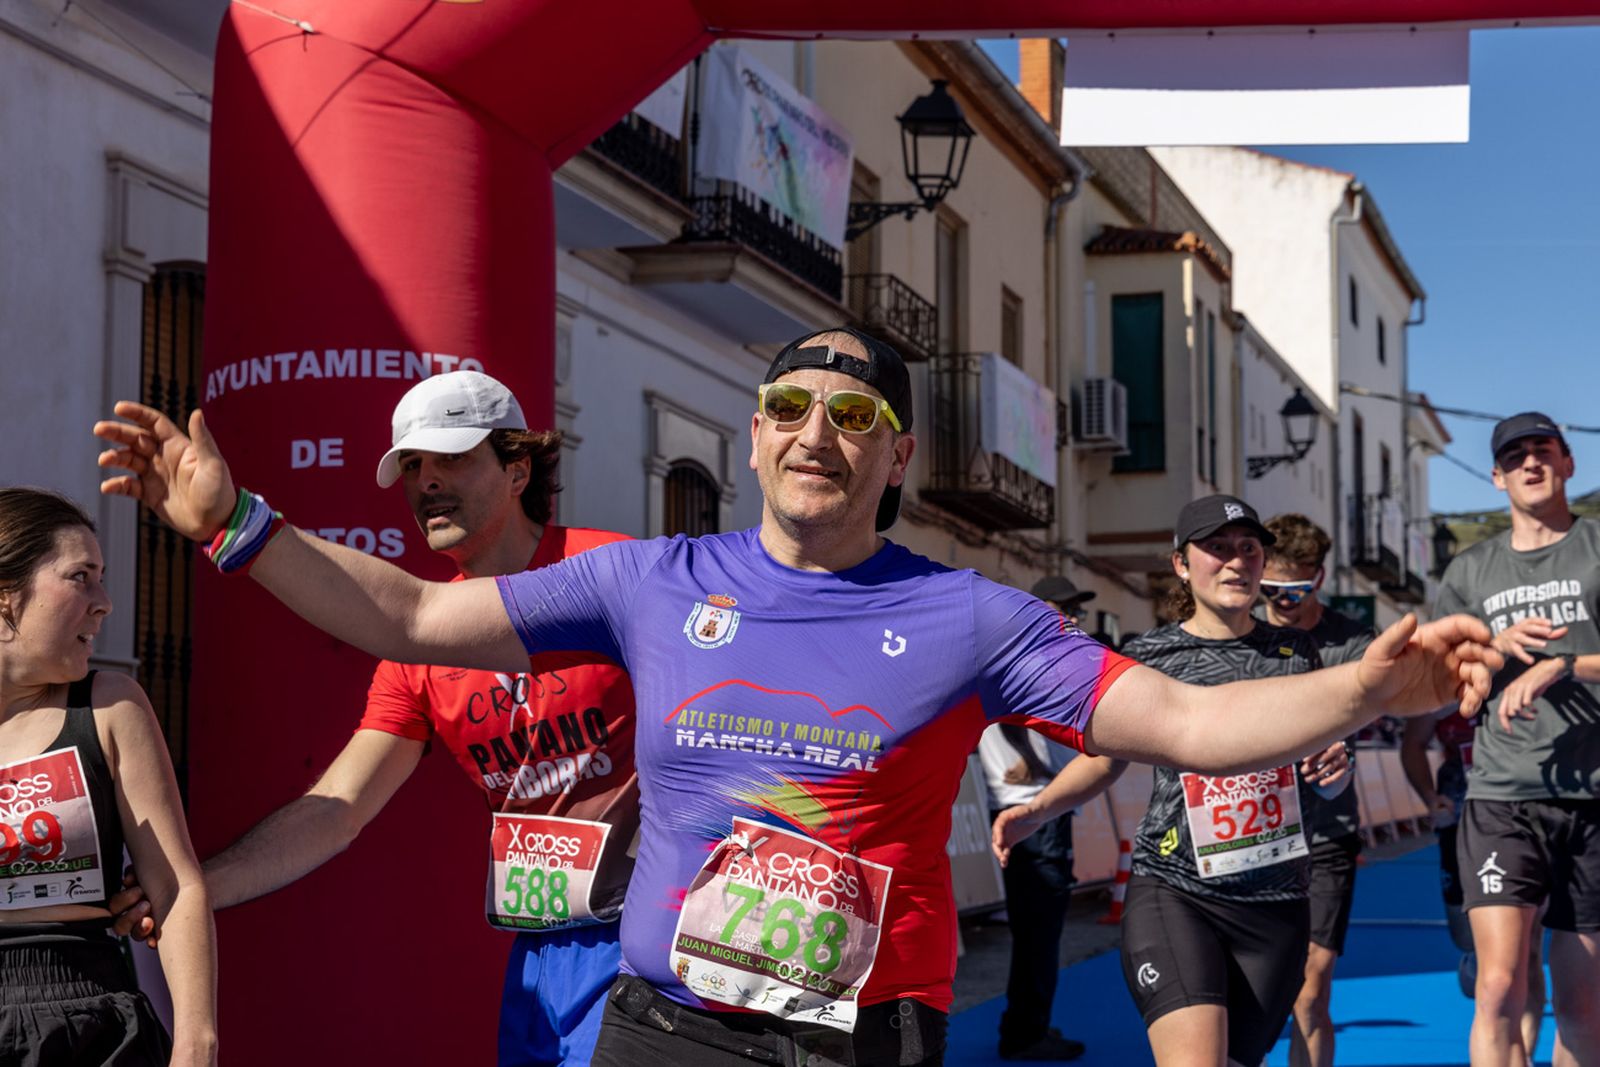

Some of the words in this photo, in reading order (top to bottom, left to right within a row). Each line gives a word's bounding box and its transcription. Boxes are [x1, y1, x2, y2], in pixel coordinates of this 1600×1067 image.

[291, 438, 344, 469] DE
[303, 528, 405, 557] TOS
[1483, 580, 1581, 615] UNIVERSIDAD
[677, 710, 773, 737] ATLETISMO
[780, 722, 790, 739] Y
[794, 724, 882, 753] MONTAÑA
[675, 729, 796, 758] MANCHA
[803, 745, 880, 773] REAL
[507, 752, 613, 800] IBORAS
[1199, 776, 1220, 796] X
[1222, 769, 1279, 791] CROSS
[1203, 785, 1269, 809] PANTANO
[1212, 794, 1283, 841] 529
[508, 823, 522, 850] X
[525, 833, 581, 856] CROSS
[506, 851, 561, 872] PANTANO
[768, 852, 859, 898] CROSS
[503, 867, 570, 919] 588
[726, 863, 837, 912] PANTANO
[1480, 874, 1503, 894] 15
[719, 882, 848, 974] 768
[677, 936, 709, 954] JUAN
[710, 946, 753, 967] MIGUEL
